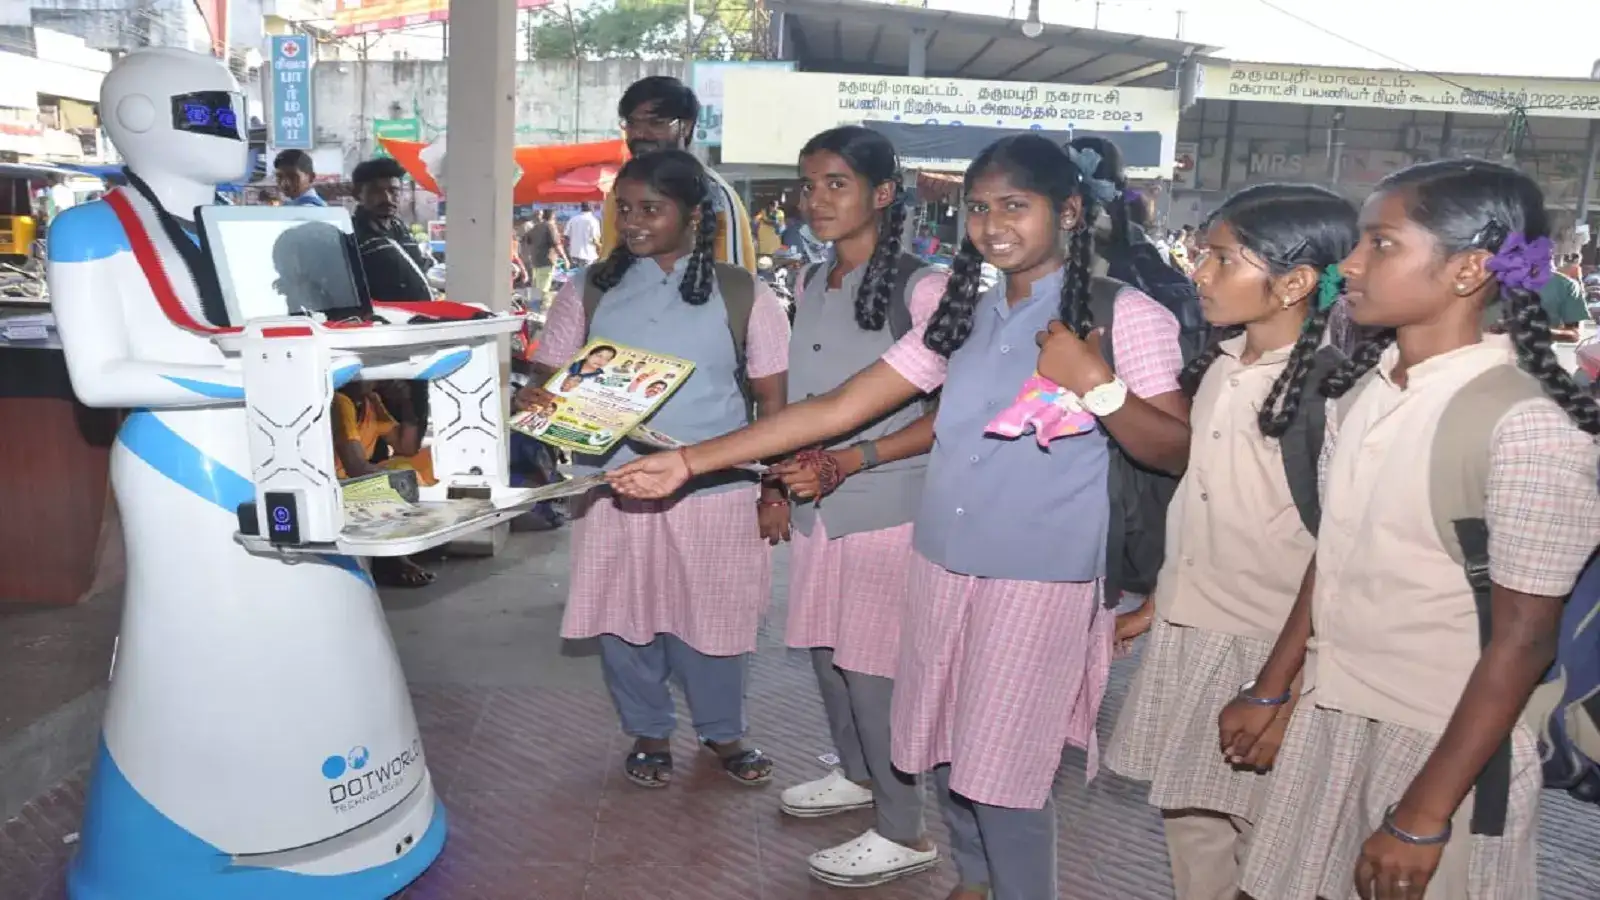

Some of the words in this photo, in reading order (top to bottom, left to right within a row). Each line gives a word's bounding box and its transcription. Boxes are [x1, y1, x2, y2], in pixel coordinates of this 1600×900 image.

[1044, 89, 1120, 105] நகராட்சி
[1060, 108, 1143, 122] 2022-2023
[1250, 153, 1302, 174] MRS
[329, 738, 421, 805] DOTWORLD
